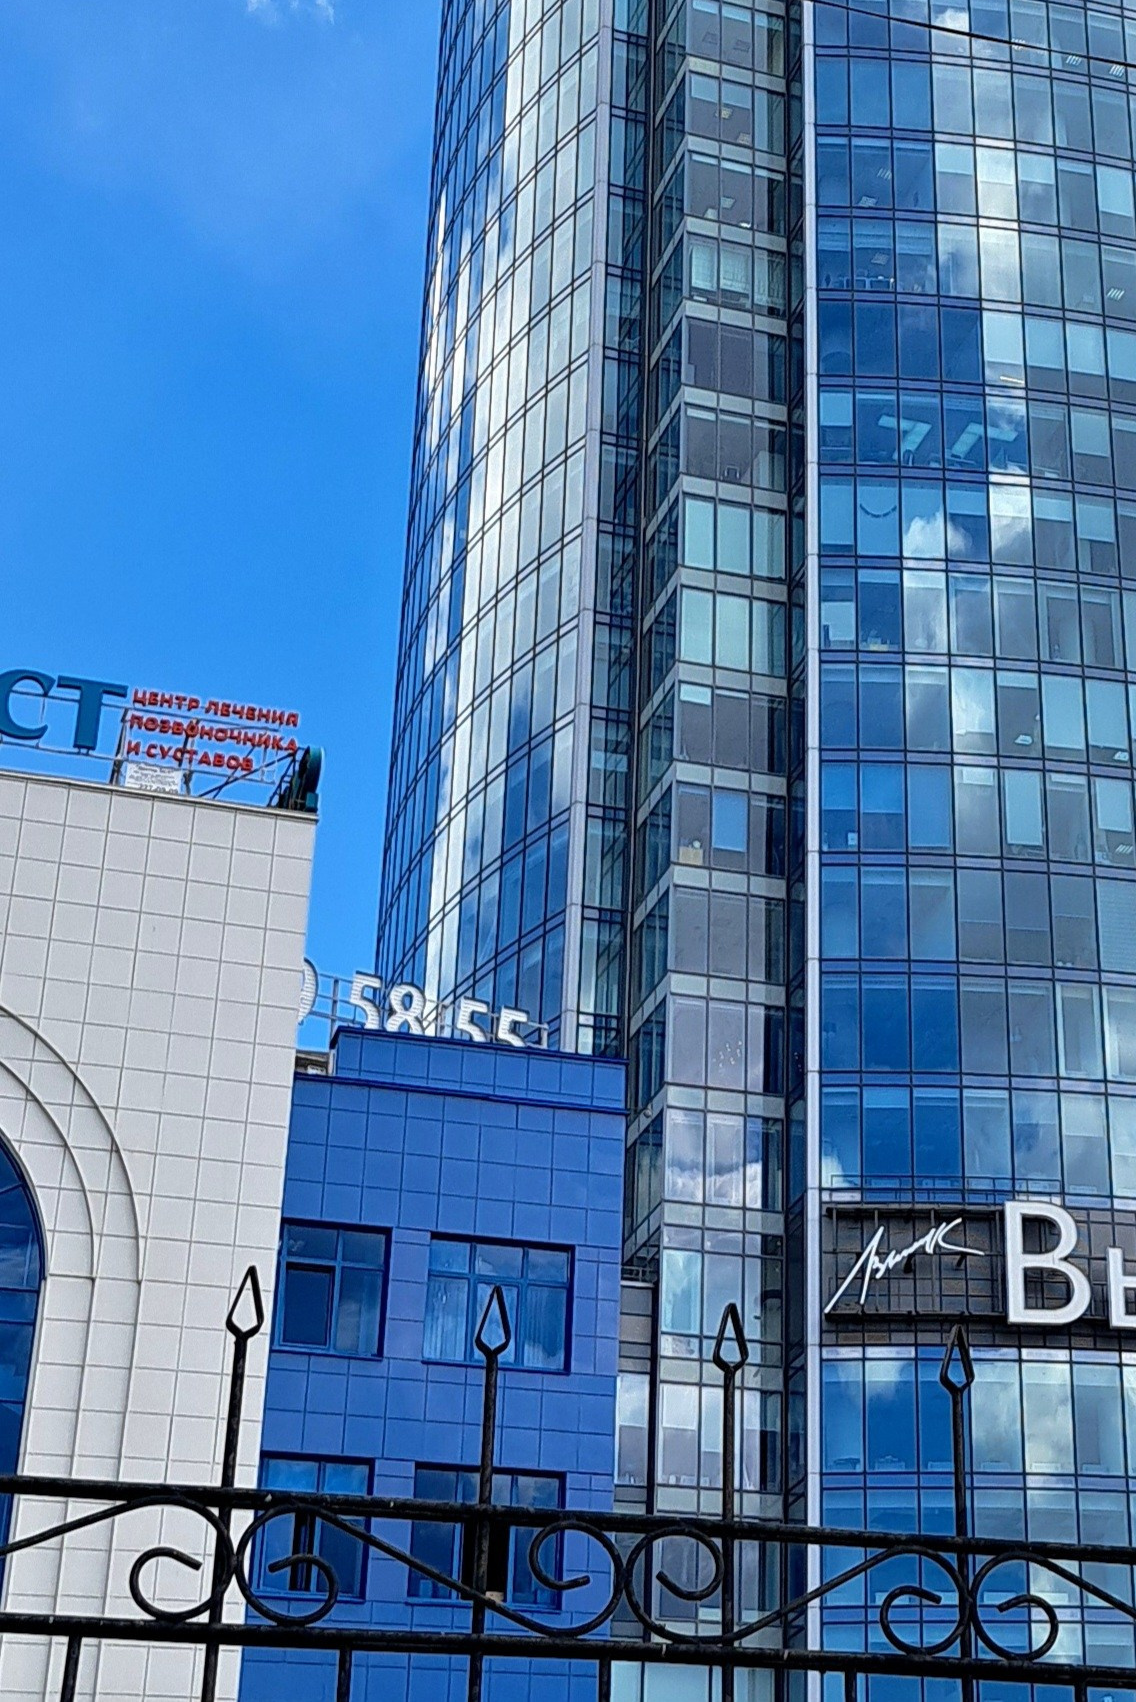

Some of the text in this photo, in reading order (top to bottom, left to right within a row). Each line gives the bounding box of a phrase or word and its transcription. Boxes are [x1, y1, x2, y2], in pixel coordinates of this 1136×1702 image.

[132, 688, 300, 727] ЦЕНТР ЛЕЧЕНИЯ
[129, 714, 298, 753] ПОЗВОНОЧНИКА
[127, 740, 255, 772] И СУСТАВОВ
[350, 970, 427, 1036] 58
[457, 996, 531, 1048] 55
